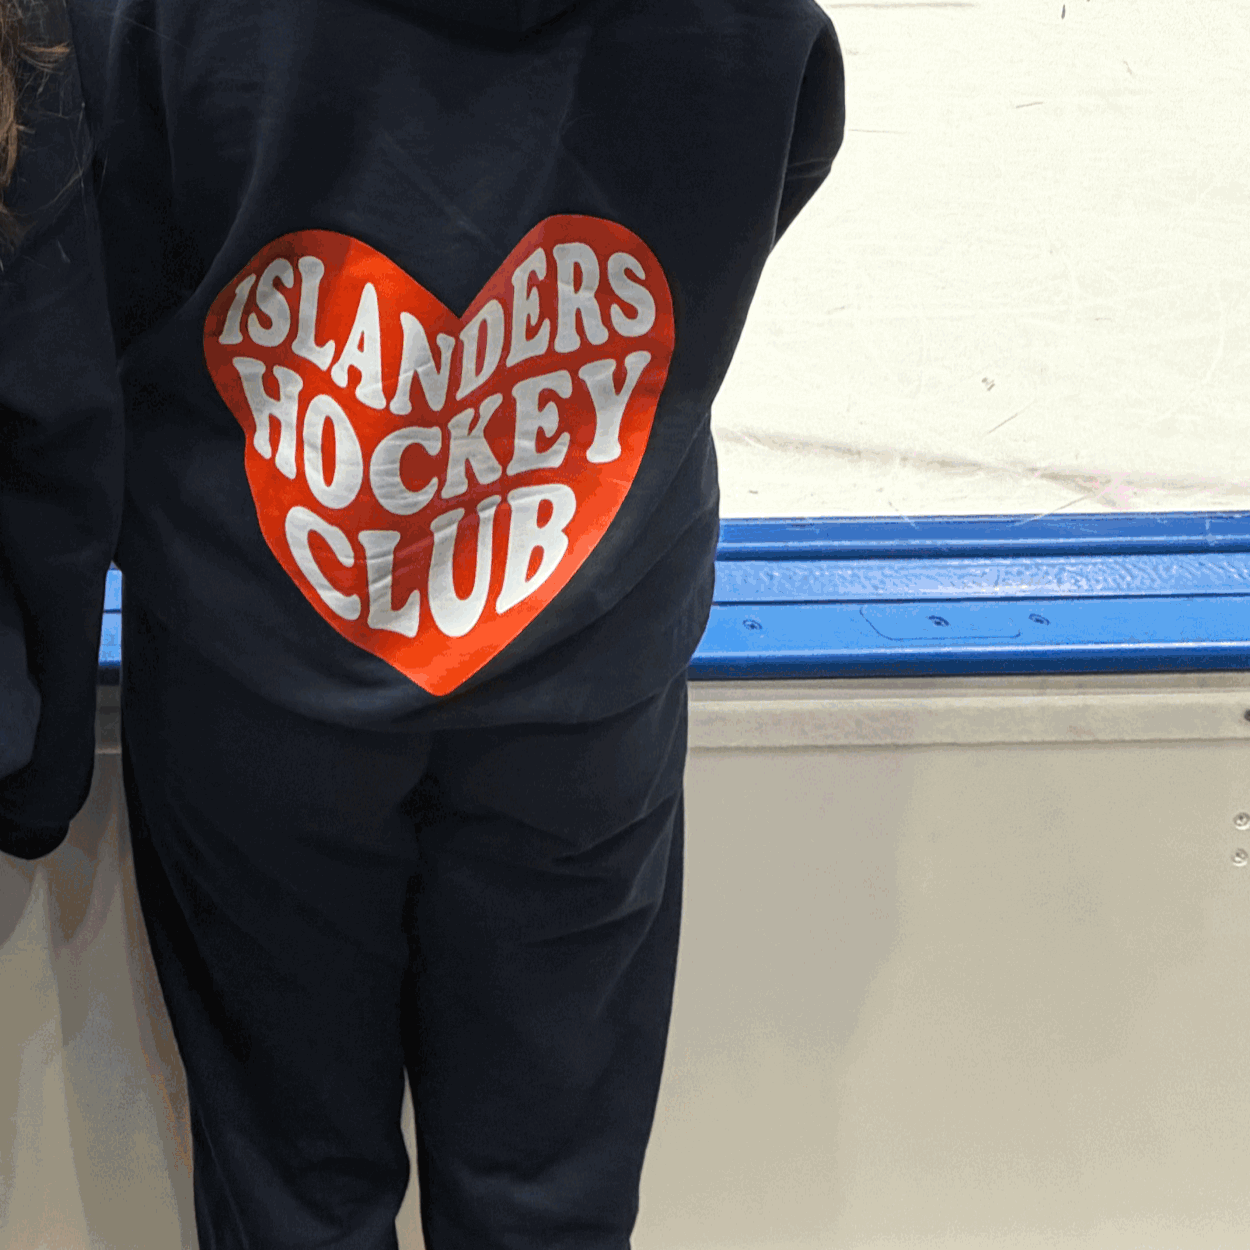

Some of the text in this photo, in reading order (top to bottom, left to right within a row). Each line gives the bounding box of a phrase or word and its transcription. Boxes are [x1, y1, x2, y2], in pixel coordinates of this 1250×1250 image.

[218, 242, 656, 415] ISLANDERS
[232, 351, 652, 515] HOCKEY
[284, 483, 578, 638] CLUB
